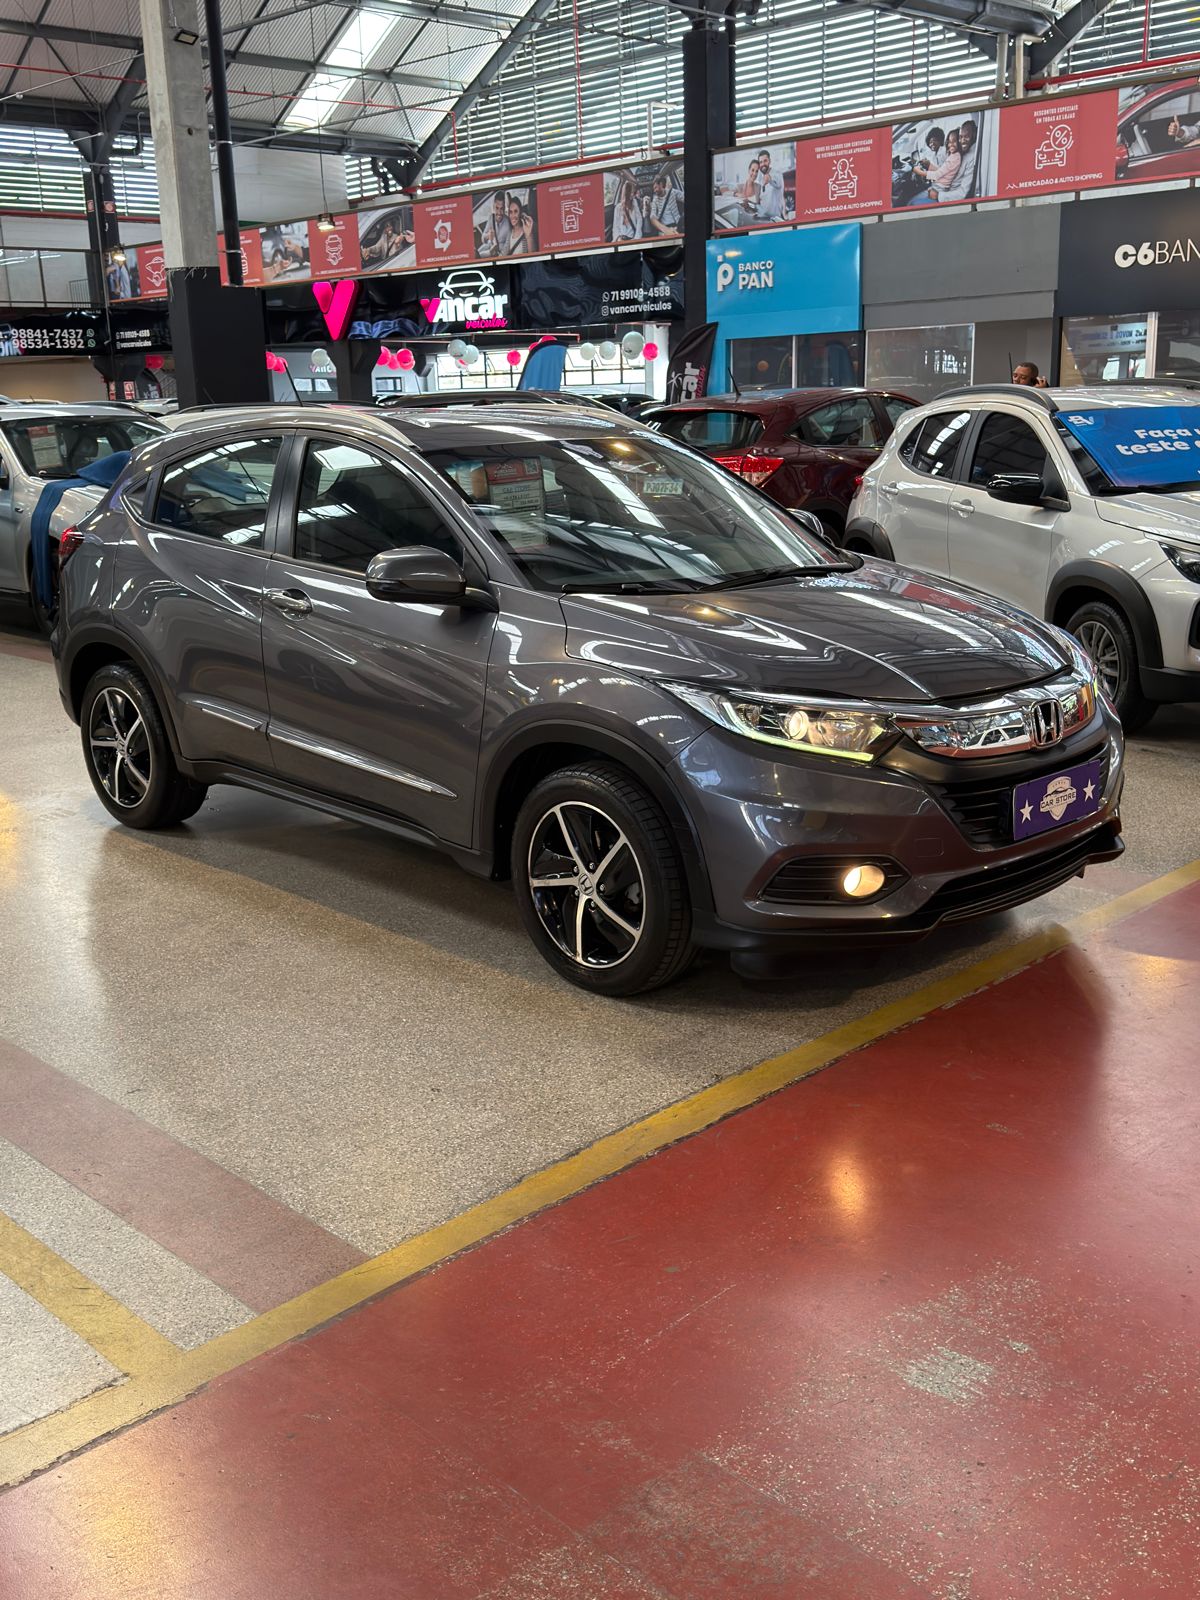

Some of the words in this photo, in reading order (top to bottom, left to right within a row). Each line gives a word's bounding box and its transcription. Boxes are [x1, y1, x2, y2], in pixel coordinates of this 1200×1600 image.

[1034, 107, 1056, 117] DESCONTOS
[1057, 104, 1079, 114] ESPECIAIS
[1043, 115, 1055, 123] TODAS
[1062, 112, 1076, 120] LOJAS
[1075, 172, 1103, 181] SHOPPING
[847, 202, 859, 210] AUTO
[859, 199, 883, 209] SHOPPING
[738, 260, 774, 272] BANCO
[738, 270, 774, 290] PAN
[610, 291, 619, 301] 71
[620, 286, 671, 300] 99109-4588
[610, 301, 672, 315] vancarveiculos
[11, 328, 83, 339] 98841-7437
[12, 338, 85, 349] 98534-1392
[1134, 427, 1193, 439] Faça
[1115, 440, 1191, 455] teste
[1041, 799, 1054, 808] CAR
[1055, 792, 1076, 803] STORE
